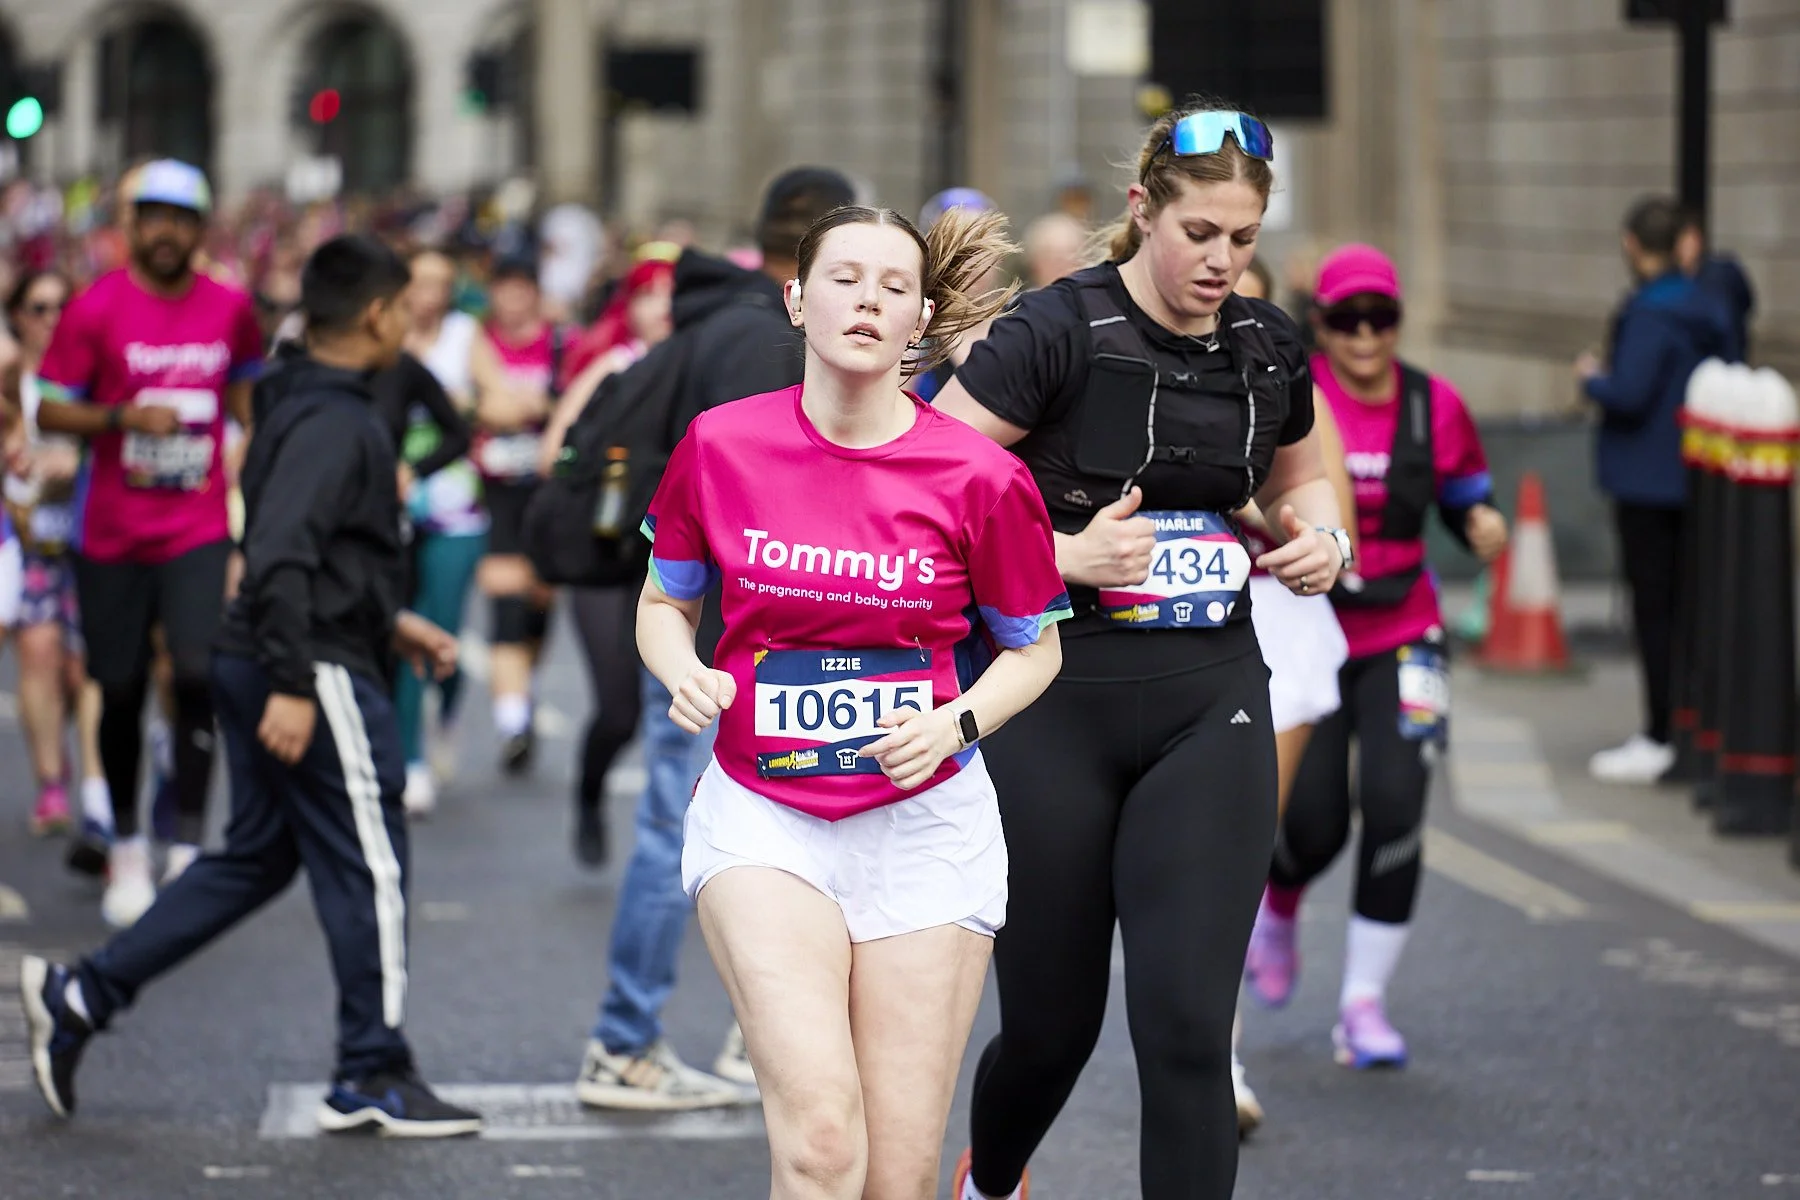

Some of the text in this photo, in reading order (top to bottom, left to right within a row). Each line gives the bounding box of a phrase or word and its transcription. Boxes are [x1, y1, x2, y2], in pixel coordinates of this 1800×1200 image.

[743, 528, 936, 592] Tommy's
[1152, 547, 1230, 585] 434
[738, 577, 933, 611] The pregnancy and baby charity
[821, 657, 862, 672] IZZIE
[769, 686, 922, 731] 10615
